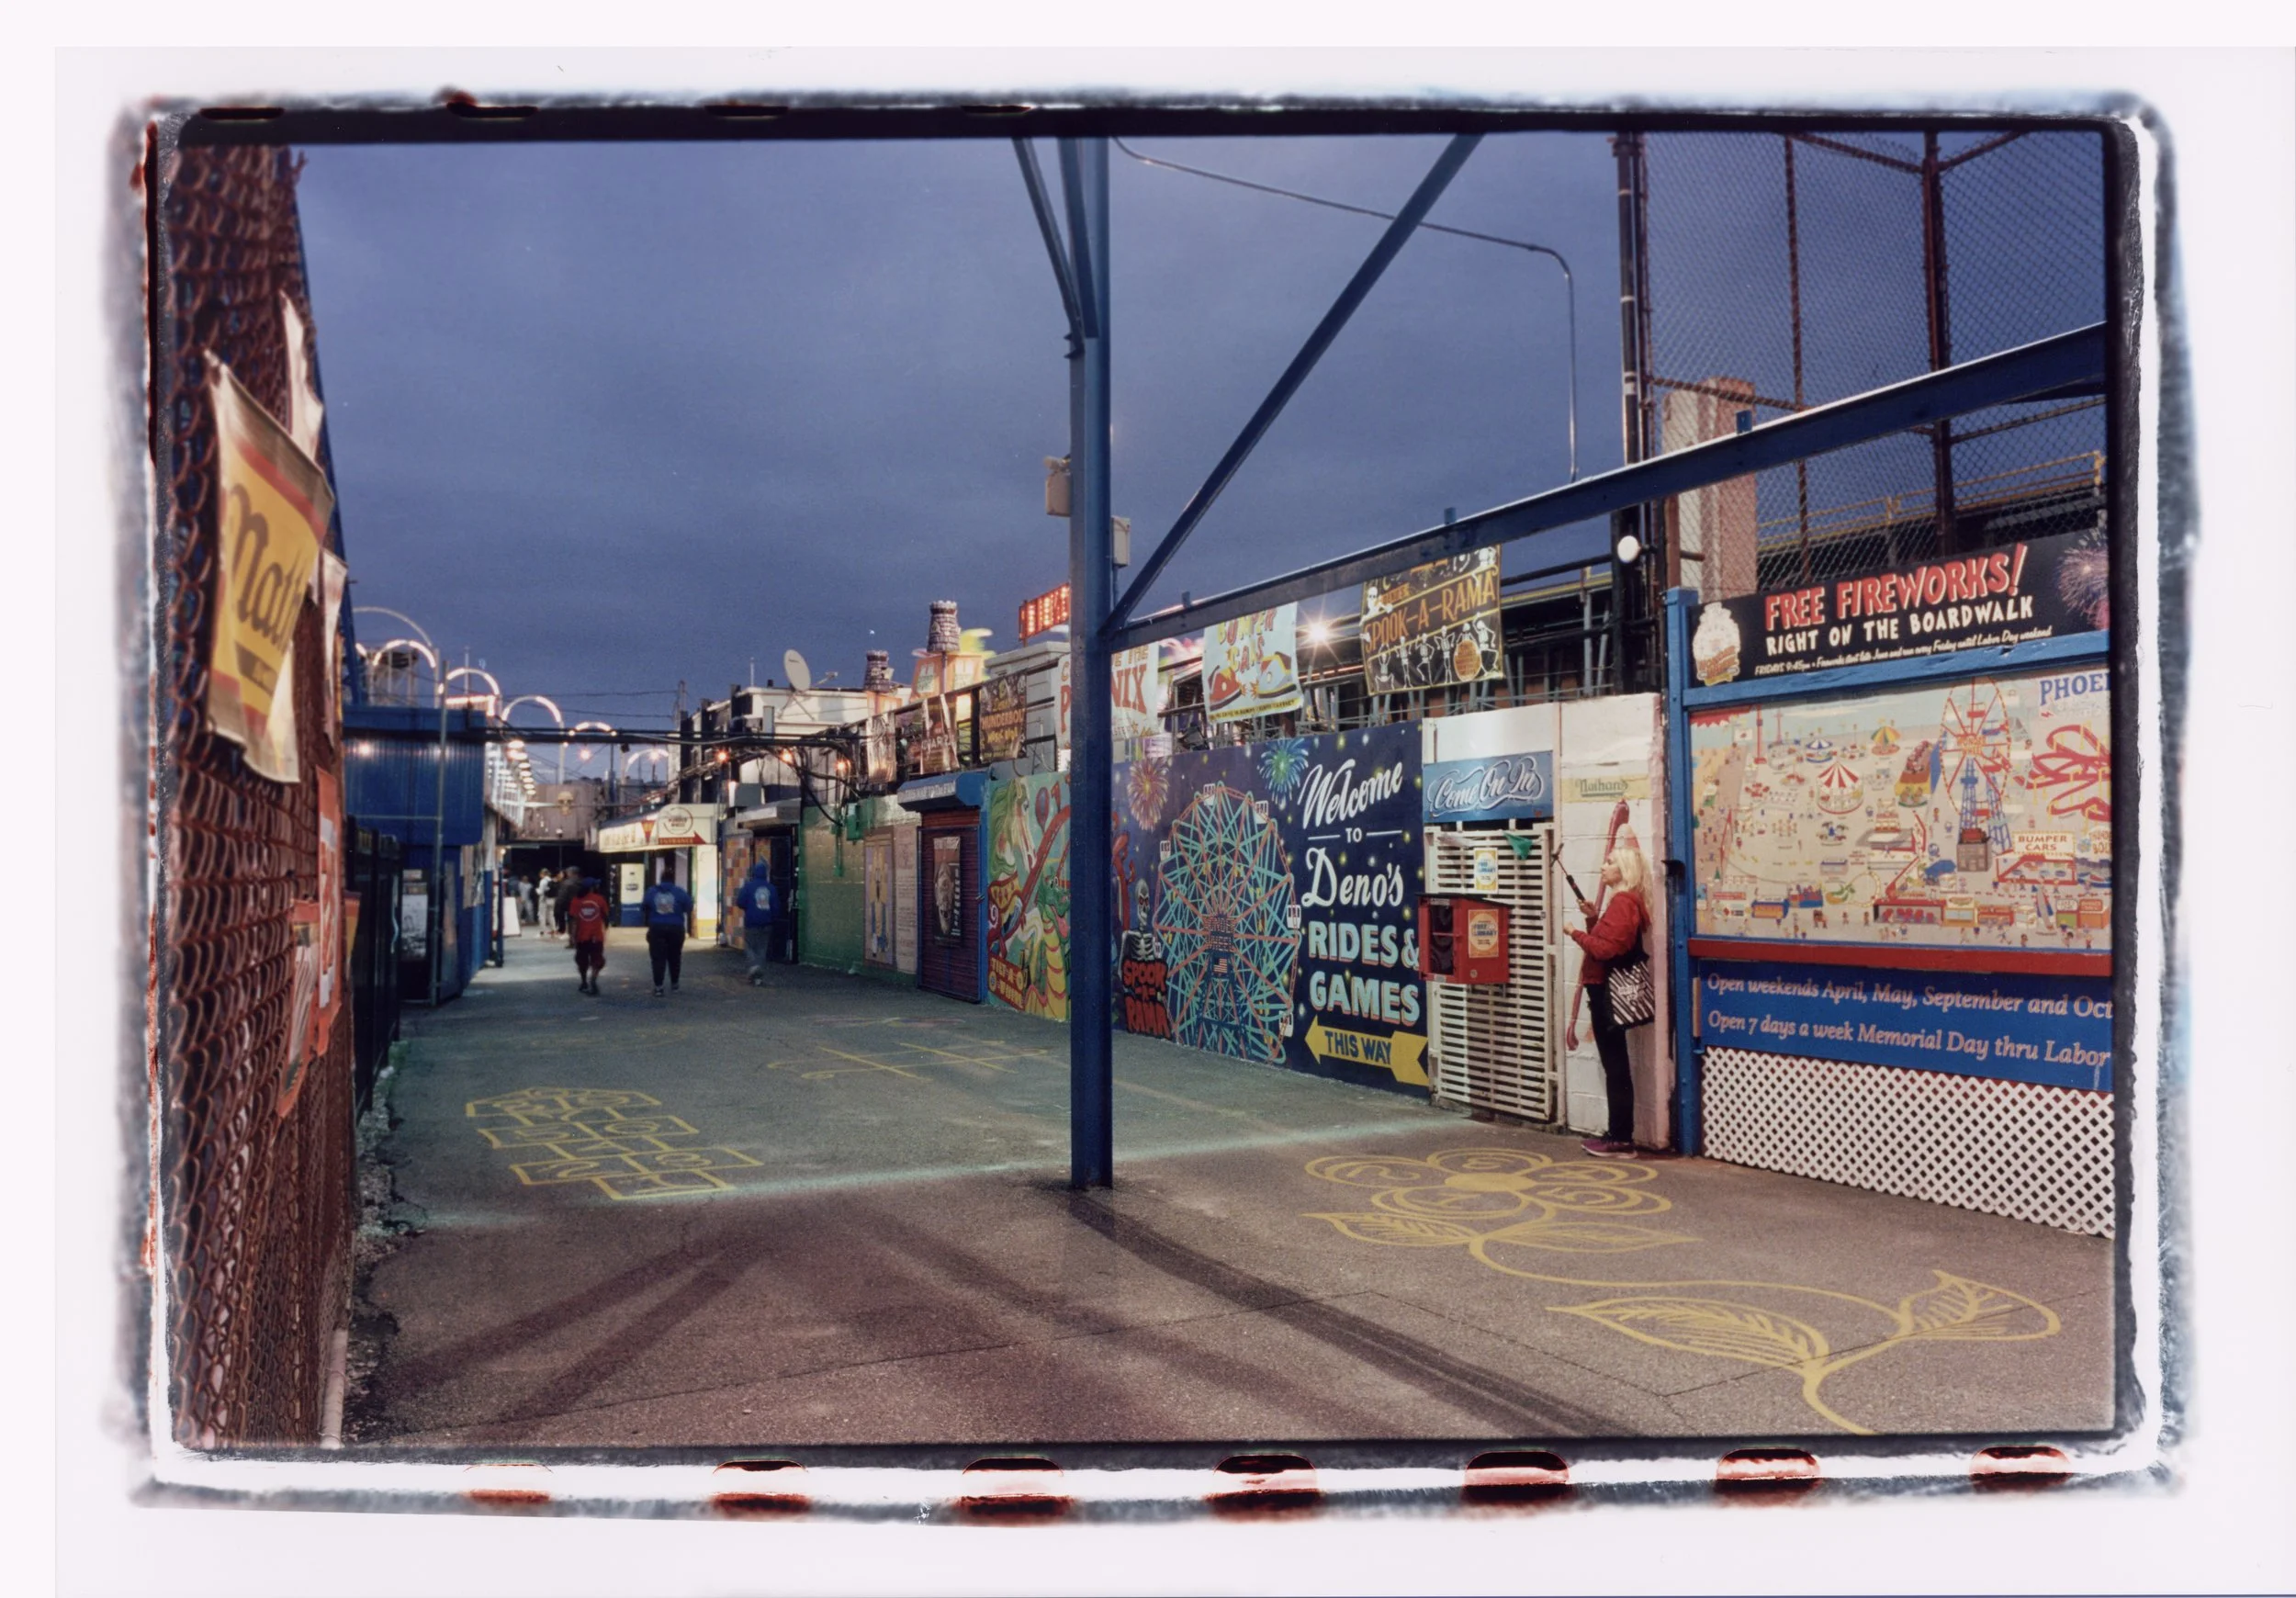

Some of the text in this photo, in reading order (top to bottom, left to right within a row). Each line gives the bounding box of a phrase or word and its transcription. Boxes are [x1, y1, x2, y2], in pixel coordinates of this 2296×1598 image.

[1364, 567, 1498, 653] SPOOK-A-RAMA
[1765, 543, 2028, 631] FREE FIREWORKS!
[1765, 595, 2033, 656] RIGHT ON THE BOARDWALK
[1873, 647, 1888, 660] June
[1933, 639, 1956, 652] Friday
[1977, 633, 2000, 646] Labor
[2001, 629, 2019, 645] Day
[1228, 635, 1265, 673] CARS
[1297, 758, 1403, 829] Welcome
[1429, 759, 1537, 811] Come On In
[1345, 827, 1362, 843] TO
[2018, 835, 2067, 843] BUMPER
[2025, 843, 2057, 851] CARS
[1301, 847, 1404, 907] Deno's
[1308, 920, 1419, 971] RIDES &
[1123, 960, 1167, 993] SPOOK
[1309, 971, 1421, 1026] GAMES
[1707, 973, 2113, 1018] Open weekends April, May, September and Oct
[1124, 996, 1172, 1040] RAMA
[1708, 1009, 2111, 1067] Open 7 days a week Memorial Day thru Labor
[1325, 1030, 1391, 1065] THIS WAY
